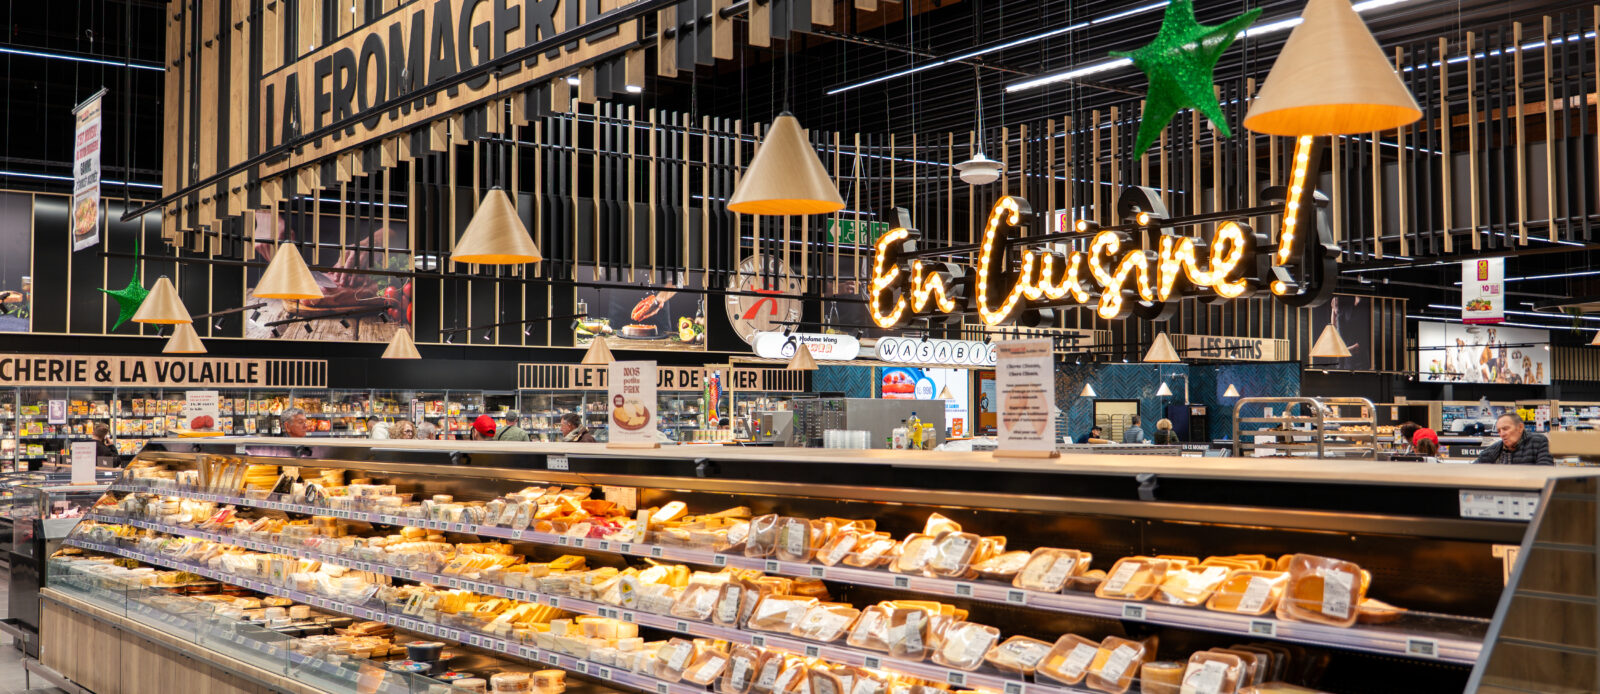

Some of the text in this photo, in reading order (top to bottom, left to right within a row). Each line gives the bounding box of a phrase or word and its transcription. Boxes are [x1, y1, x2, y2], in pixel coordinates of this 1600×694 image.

[265, 0, 619, 165] LA FROMAGER
[869, 227, 956, 329] En
[976, 194, 1248, 327] Cuisine
[1482, 284, 1490, 292] 10
[1200, 337, 1263, 360] LES PAINS
[0, 358, 259, 384] CHERIE & LA VOLAILLE
[575, 368, 593, 387] LE
[679, 370, 699, 388] DE
[726, 371, 758, 389] MER
[1461, 448, 1468, 456] EN
[1469, 448, 1476, 456] CE
